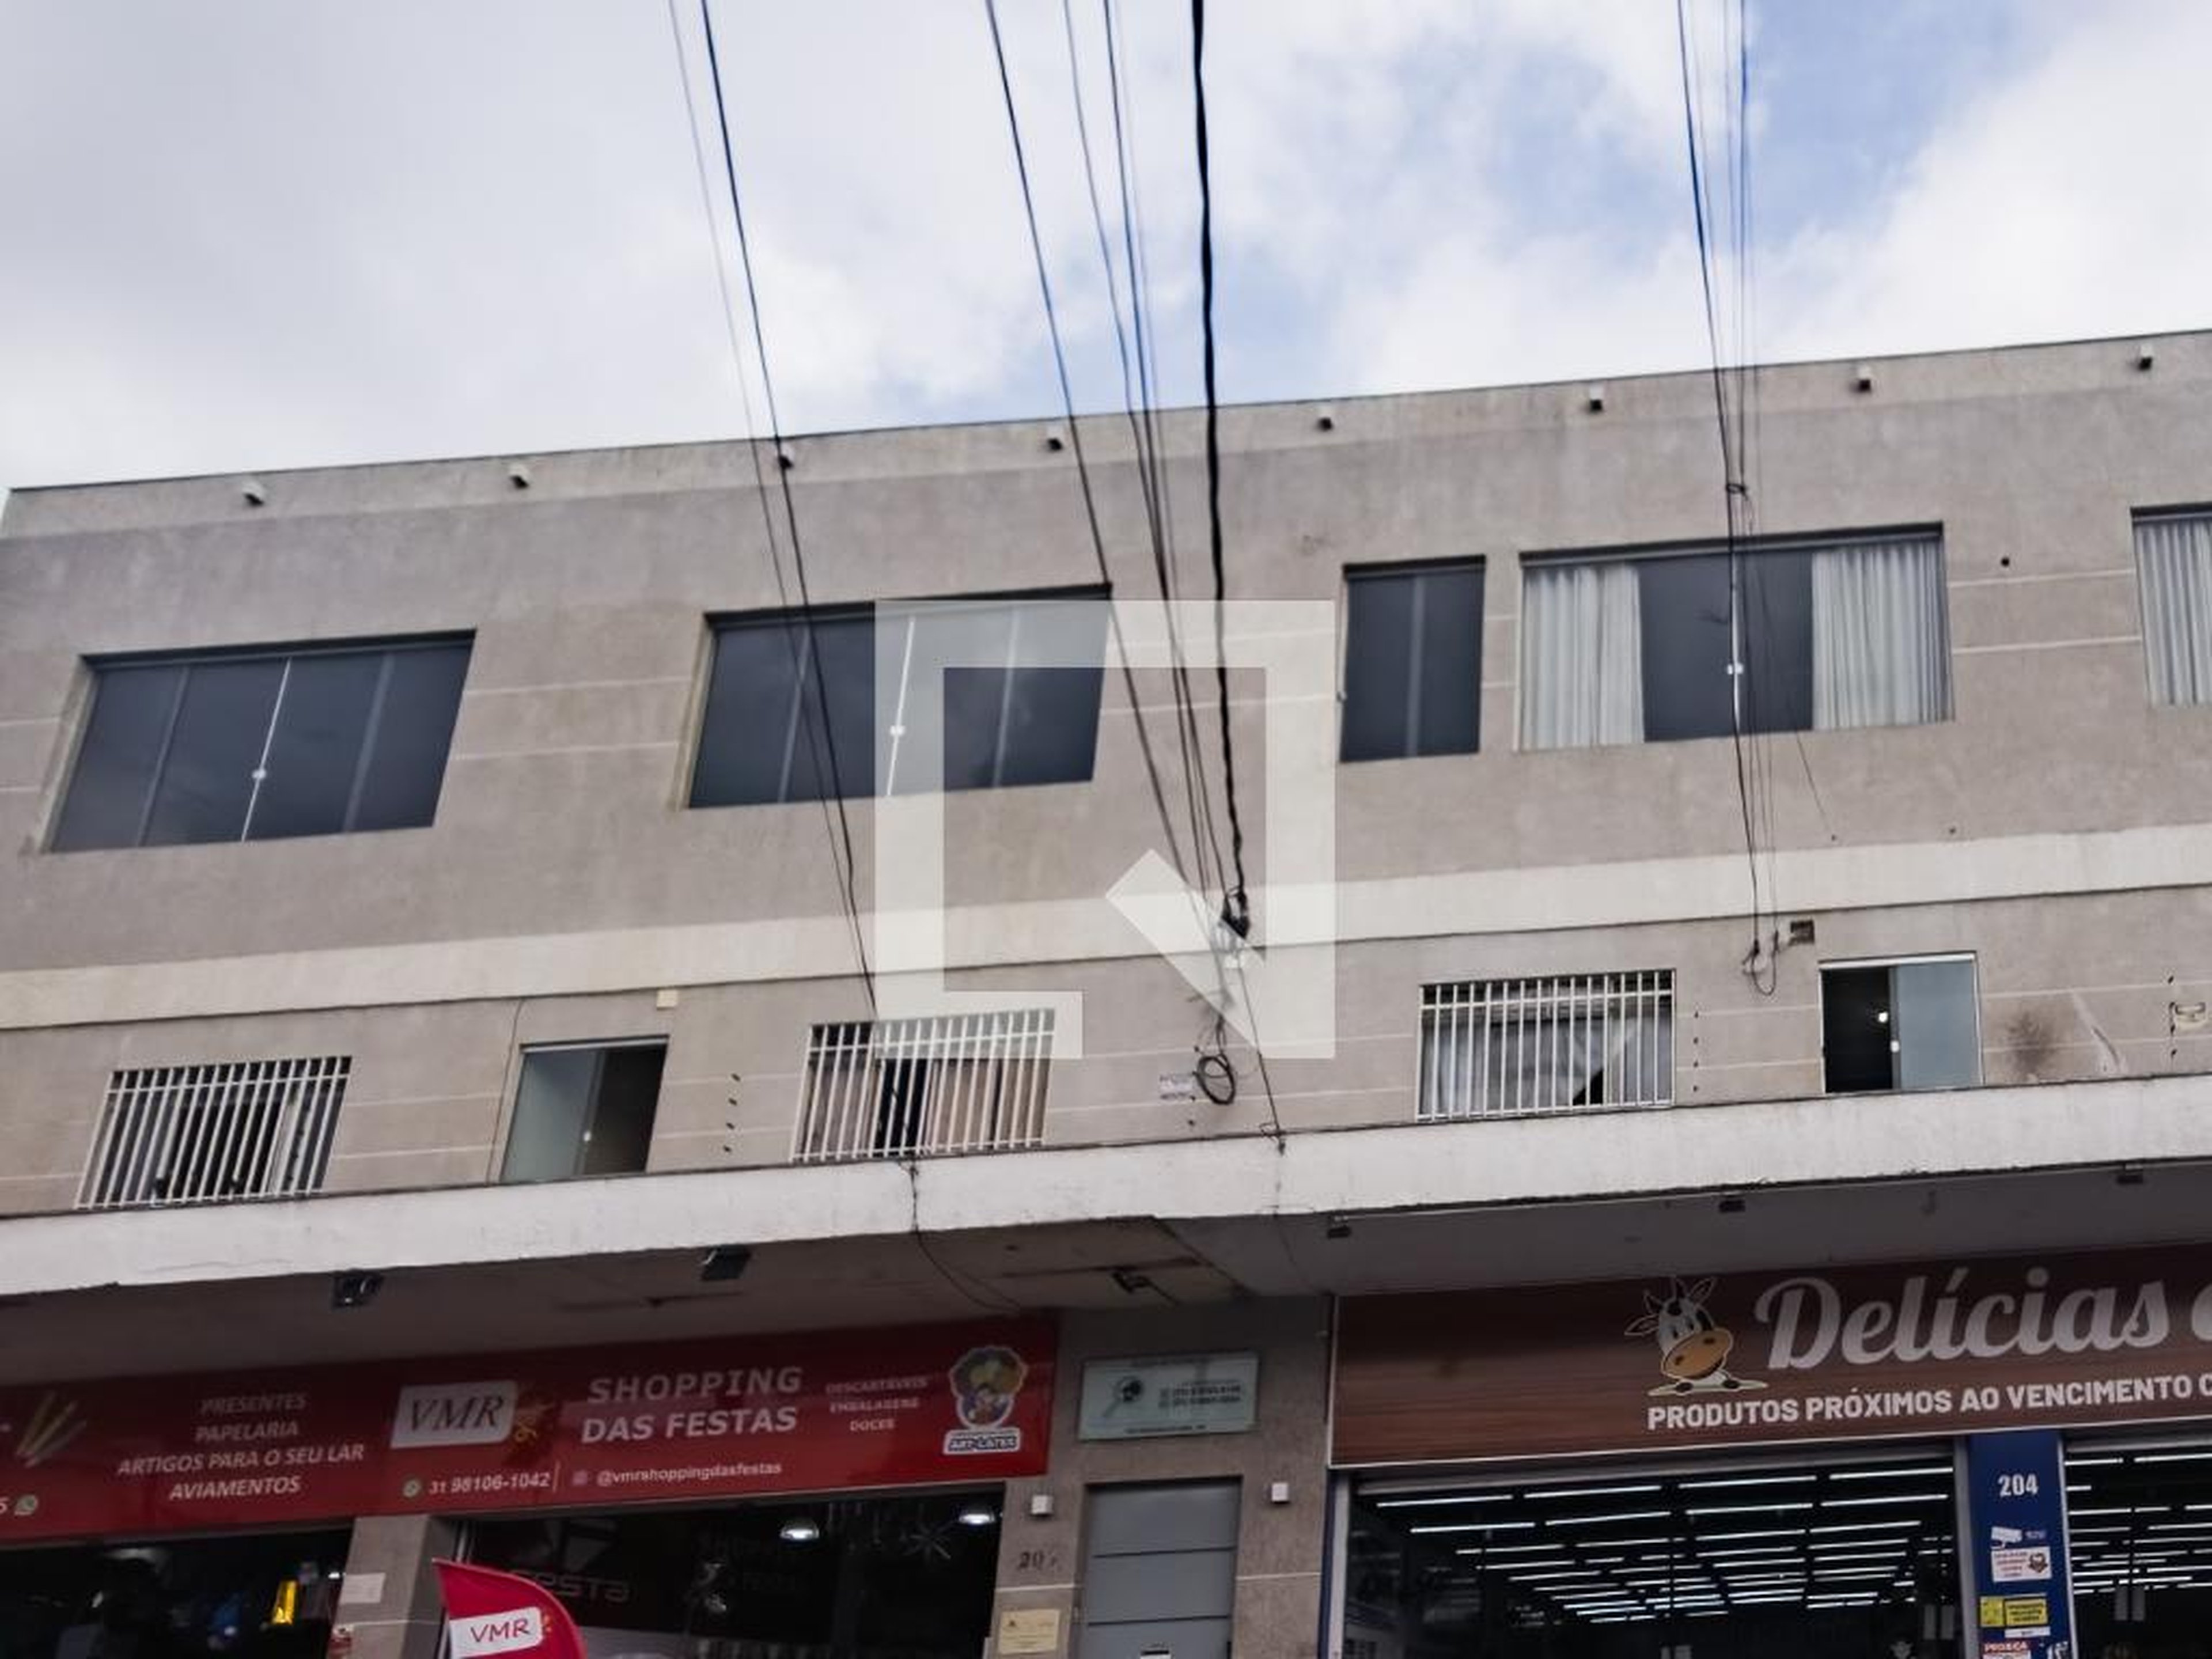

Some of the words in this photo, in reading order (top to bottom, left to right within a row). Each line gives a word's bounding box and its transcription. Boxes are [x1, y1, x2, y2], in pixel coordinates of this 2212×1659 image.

[1753, 1267, 2170, 1370] Delícias
[588, 1366, 802, 1404] SHOPPING
[200, 1392, 306, 1415] PRESENTES
[410, 1395, 503, 1433] VMR
[1647, 1399, 1800, 1431] PRODUTOS
[1805, 1387, 1952, 1419] PRÓXIMOS
[1959, 1386, 1999, 1411] AO
[2006, 1374, 2192, 1407] VENCIMENTO
[195, 1420, 298, 1442] PAPELARIA
[581, 1417, 653, 1443] DAS
[667, 1406, 798, 1438] FESTAS
[117, 1453, 203, 1475] ARTIGOS
[208, 1449, 259, 1469] PARA
[263, 1448, 281, 1467] O
[285, 1446, 323, 1465] SEU
[327, 1443, 365, 1462] LAR
[169, 1476, 301, 1501] AVIAMENTOS
[596, 1463, 782, 1487] @vmrshoppingdasfestas
[1998, 1473, 2040, 1497] 204
[469, 1617, 531, 1643] VMR
